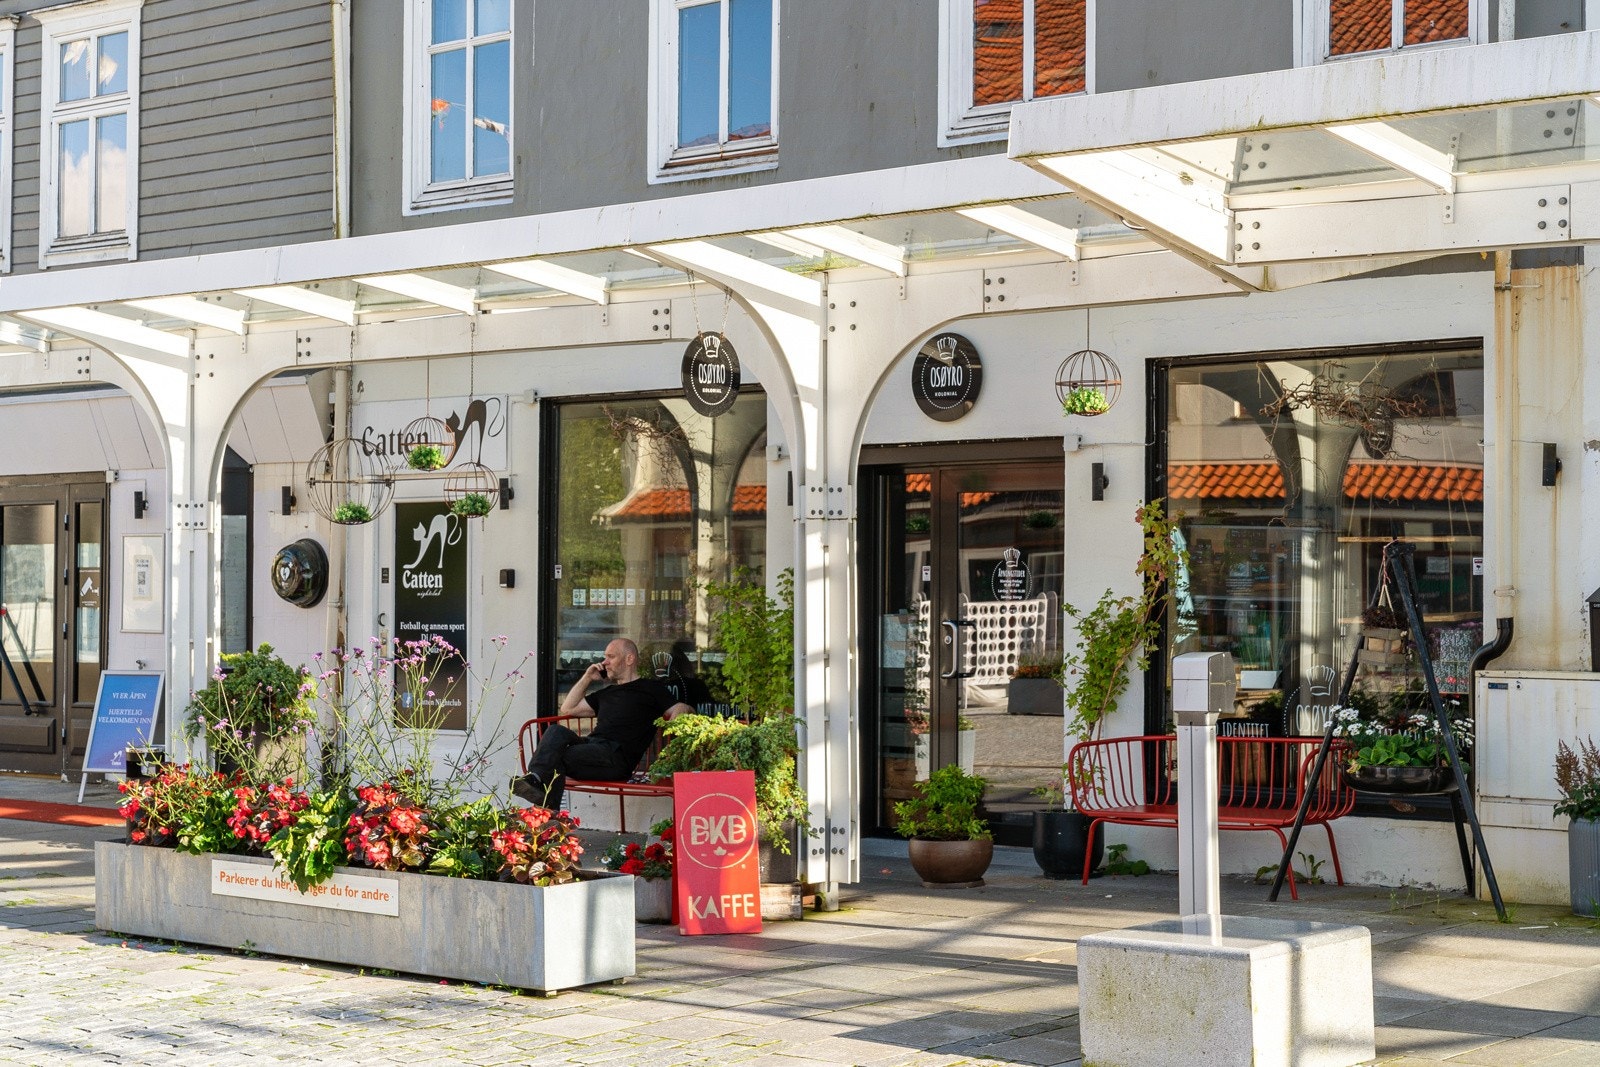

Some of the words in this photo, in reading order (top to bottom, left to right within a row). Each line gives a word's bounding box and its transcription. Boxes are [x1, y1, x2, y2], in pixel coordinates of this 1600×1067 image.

[698, 363, 726, 384] OSØYRO
[930, 365, 963, 387] OSØYRO
[402, 569, 443, 589] Catten
[400, 622, 421, 630] Fotball
[421, 623, 429, 632] og
[449, 623, 465, 632] sport
[129, 691, 147, 699] ÅPEN
[108, 708, 143, 716] HJERTELIG
[1295, 704, 1334, 734] OSØY
[1222, 721, 1270, 738] IDENTITET
[690, 814, 747, 846] BKB
[219, 871, 259, 887] Parkerer
[261, 875, 273, 888] du
[275, 877, 292, 892] her,
[293, 881, 328, 897] snger
[330, 884, 342, 897] du
[345, 885, 359, 898] for
[361, 888, 390, 902] andre
[687, 893, 756, 920] KAFFE
